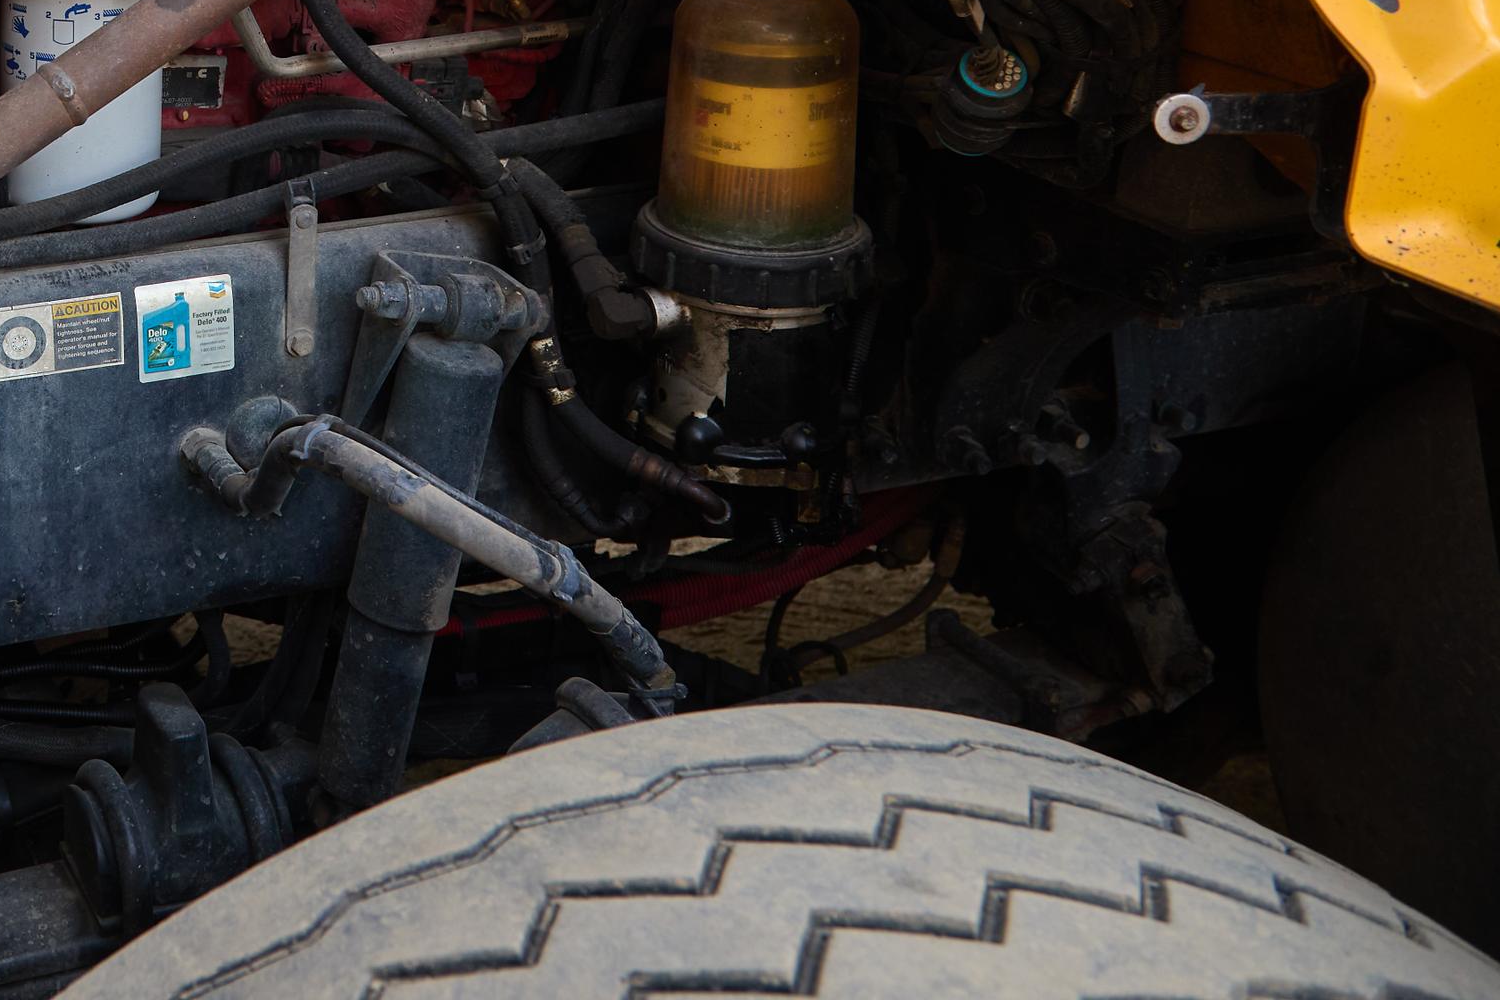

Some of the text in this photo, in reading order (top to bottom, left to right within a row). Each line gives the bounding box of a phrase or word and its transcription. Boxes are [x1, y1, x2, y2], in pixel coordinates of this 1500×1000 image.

[45, 11, 52, 19] 2
[30, 51, 35, 60] 5
[65, 300, 118, 315] CAUTION
[57, 321, 81, 329] Maintain
[57, 329, 84, 337] tightness.
[148, 328, 168, 338] Delo
[58, 351, 86, 360] tightening
